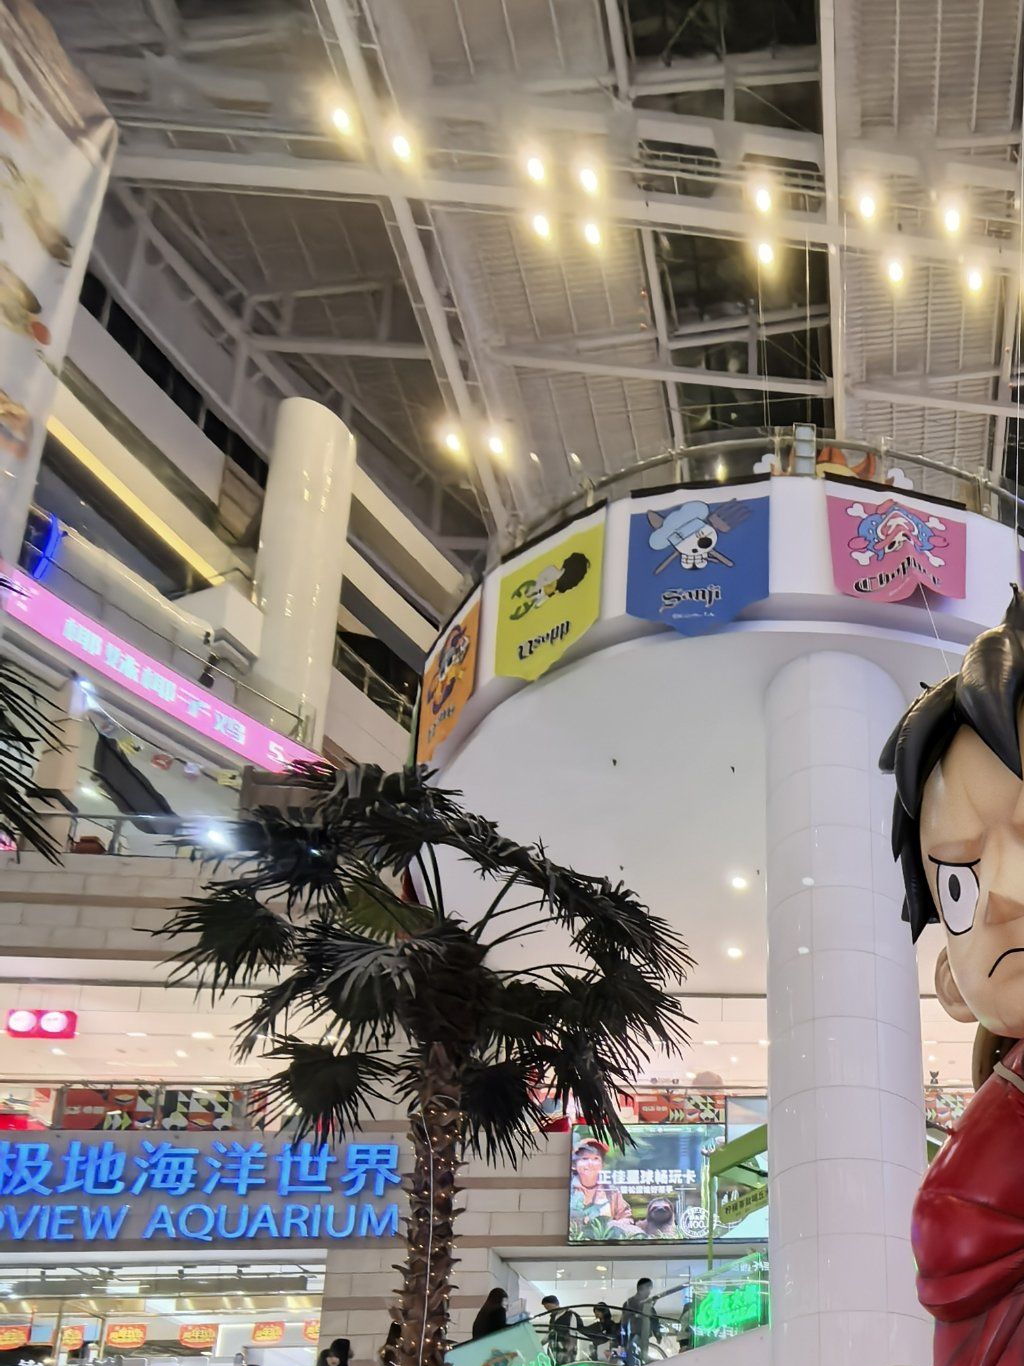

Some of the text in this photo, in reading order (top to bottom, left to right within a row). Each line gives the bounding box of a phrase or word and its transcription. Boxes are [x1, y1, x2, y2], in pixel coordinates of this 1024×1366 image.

[659, 584, 722, 612] Sanji
[0, 1140, 401, 1196] 极地海洋世界
[0, 1203, 399, 1242] VIEW AQUARIUM
